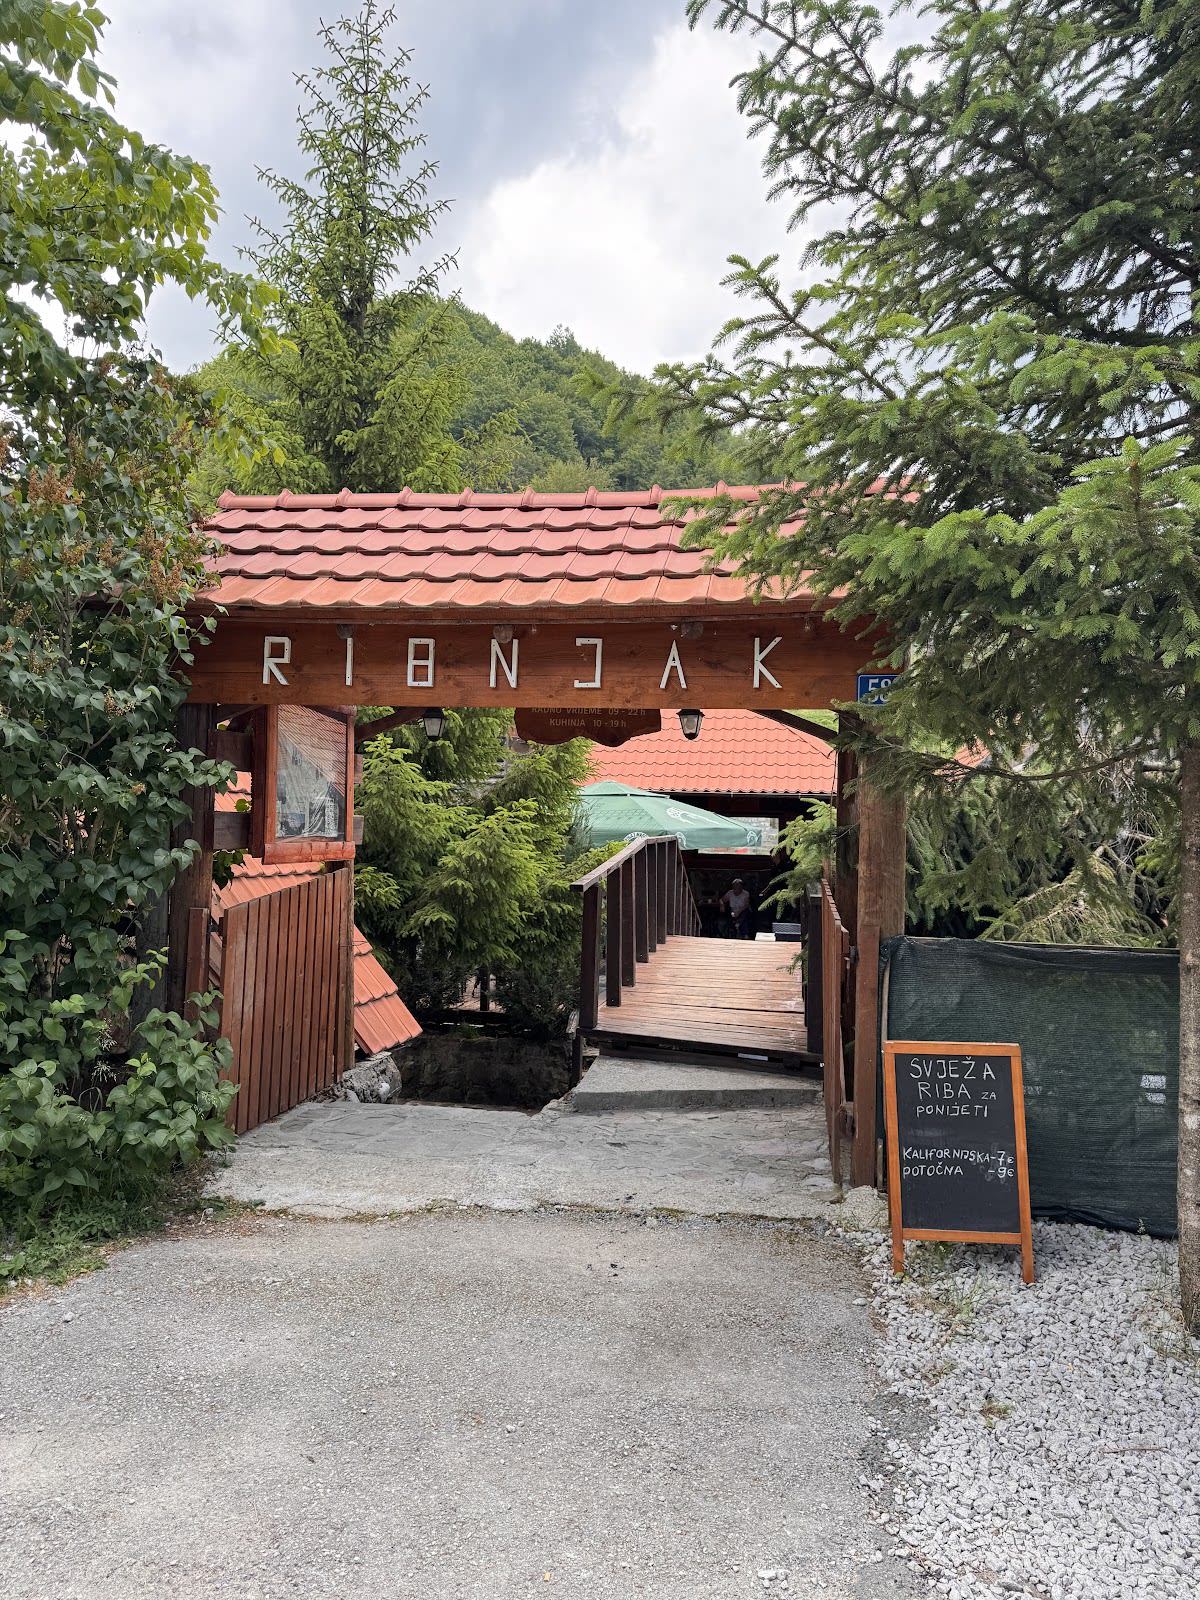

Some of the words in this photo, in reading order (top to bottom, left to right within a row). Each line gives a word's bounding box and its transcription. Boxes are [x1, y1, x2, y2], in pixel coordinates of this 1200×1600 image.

[549, 718, 586, 727] KUHINJA
[909, 1056, 996, 1080] SVJEŽA
[917, 1081, 972, 1101] RIBA
[981, 1091, 997, 1100] ZA
[916, 1102, 988, 1118] PONIJETI
[903, 1162, 964, 1179] POTOČNA
